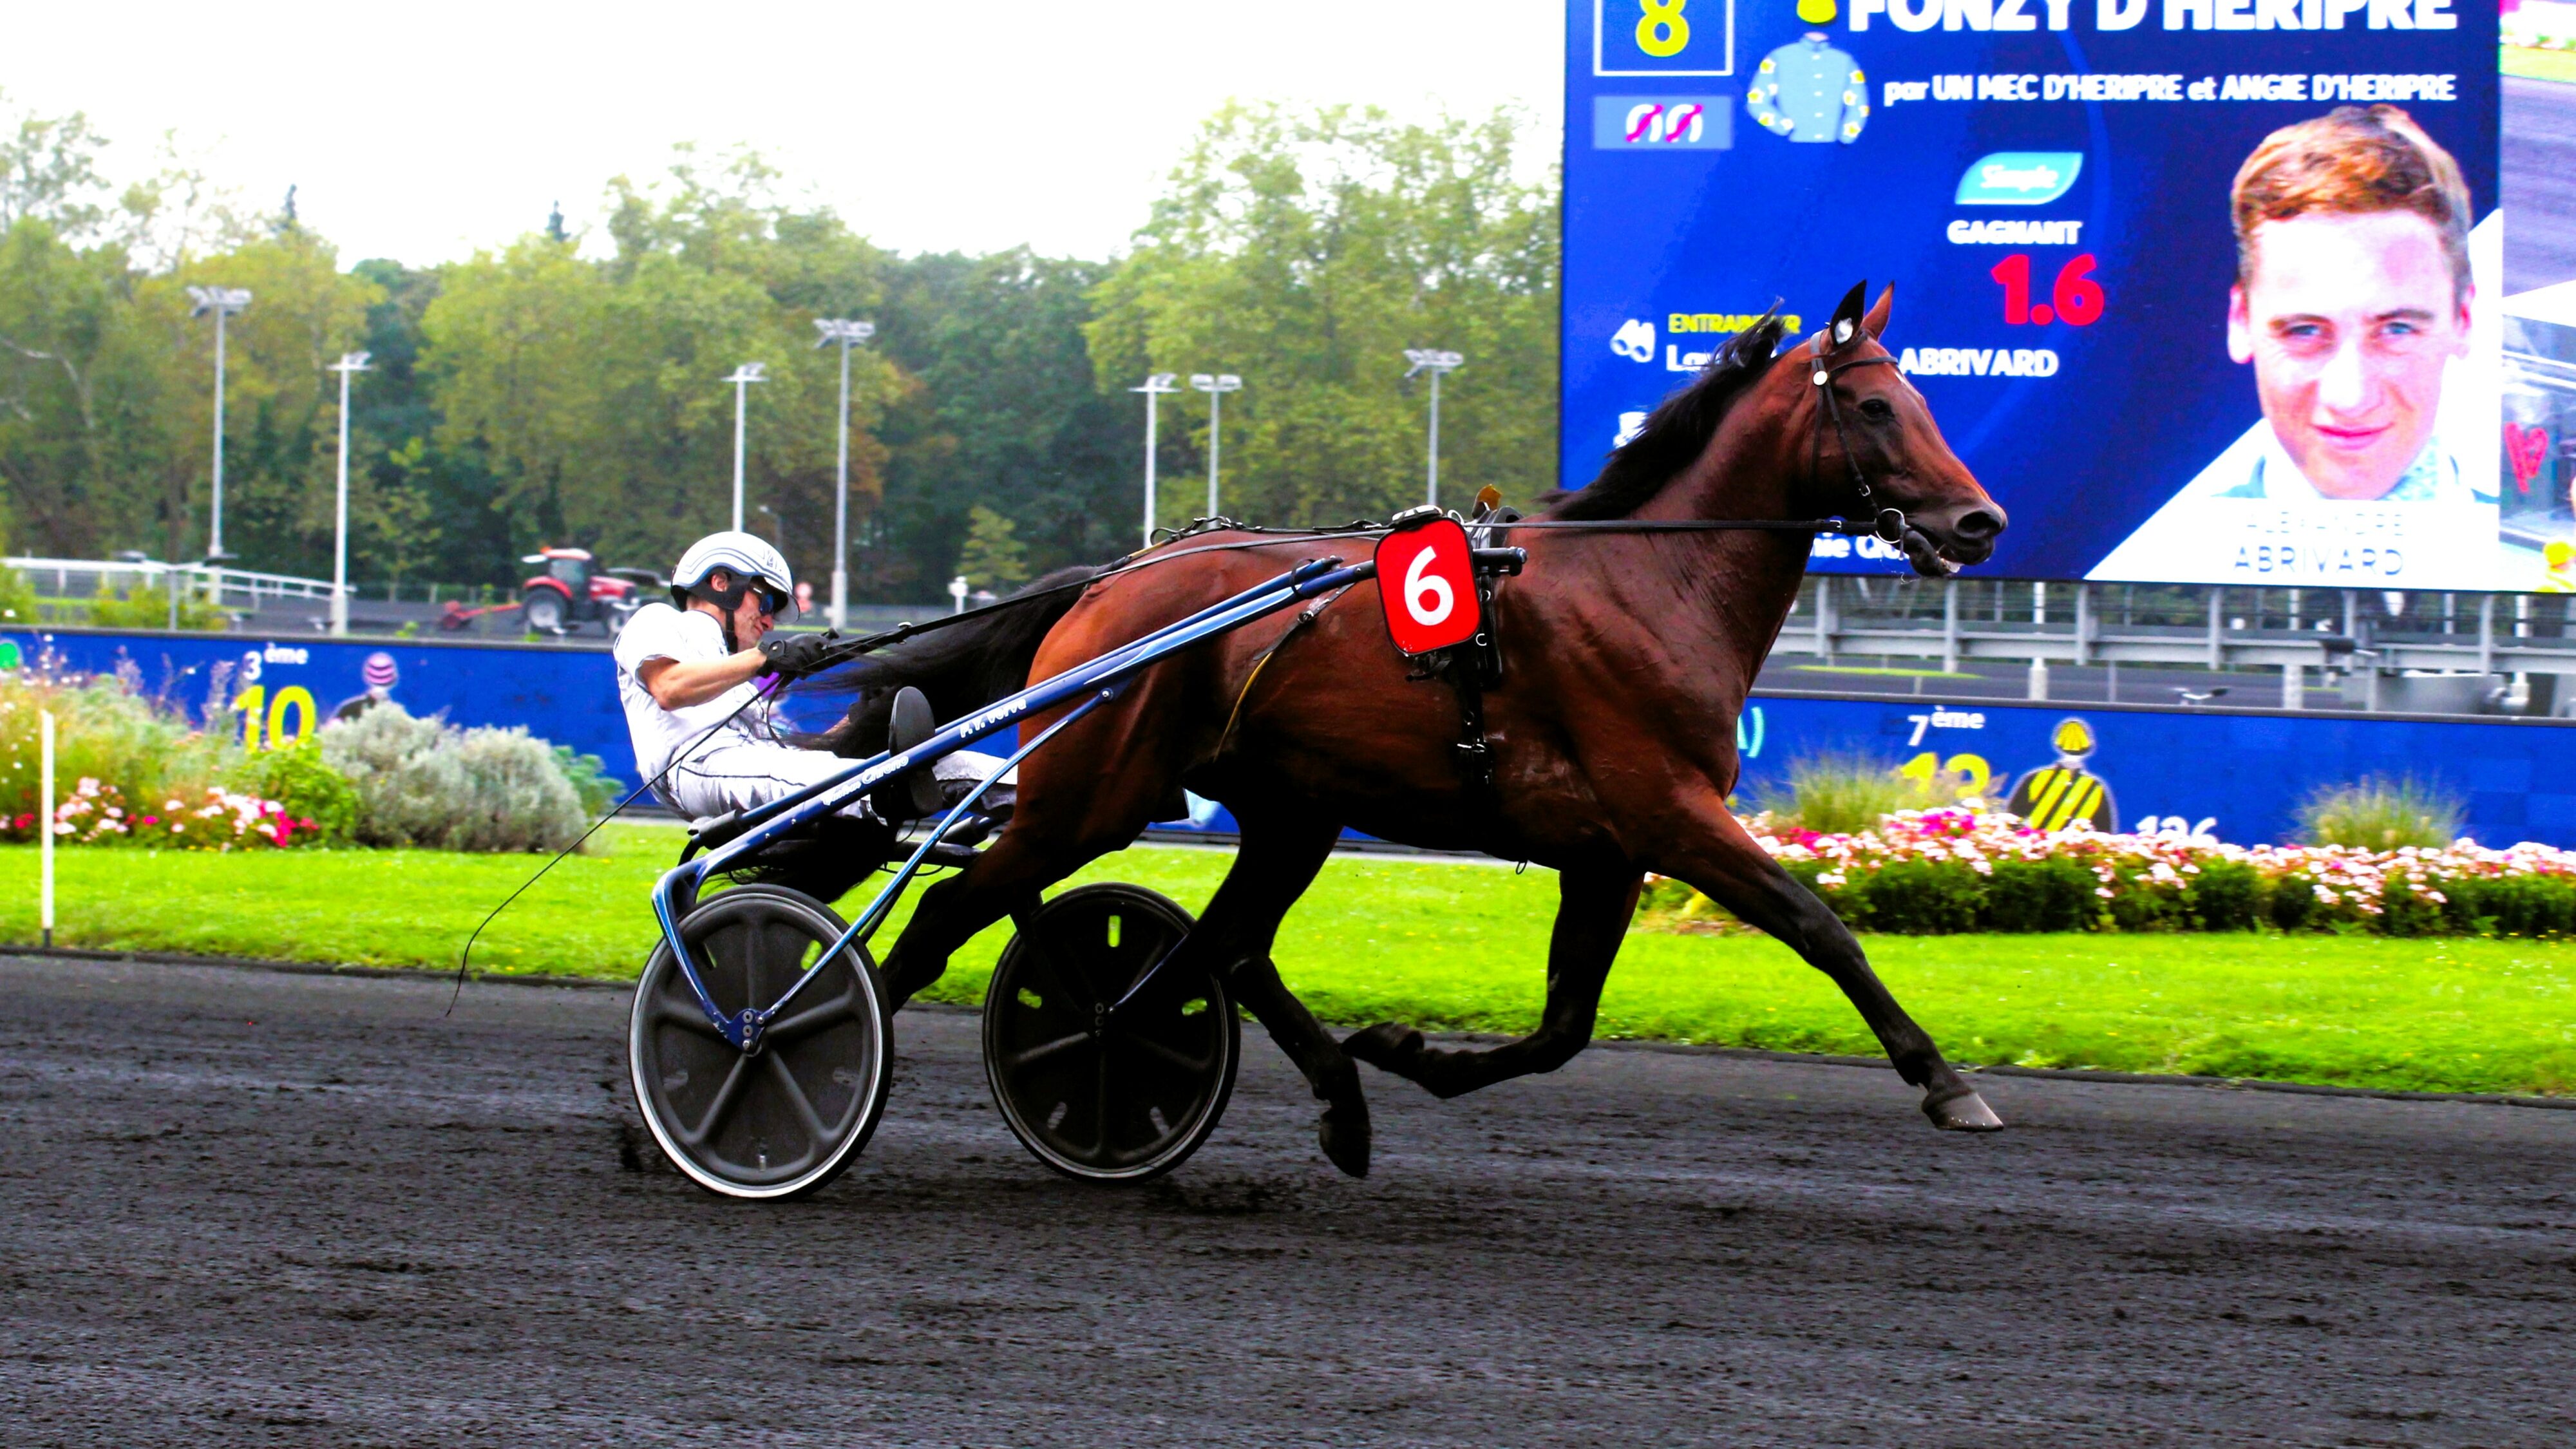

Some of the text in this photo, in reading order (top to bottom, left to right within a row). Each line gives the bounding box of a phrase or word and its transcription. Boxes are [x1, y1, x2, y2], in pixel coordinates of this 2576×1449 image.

[1636, 0, 1690, 57] 8
[2097, 0, 2458, 30] DHERIPRE
[1884, 74, 2457, 106] par UN MEC D'HERIPRE et ANGIE D'HERIPRE
[1947, 220, 2083, 245] GAGNANT
[1991, 253, 2105, 327] 1.6
[1899, 348, 2059, 377] ABRIVARD
[2233, 545, 2404, 576] ABRIVARD
[1404, 545, 1454, 626] 6
[236, 685, 316, 753] 10
[1907, 705, 1985, 747] 7ème
